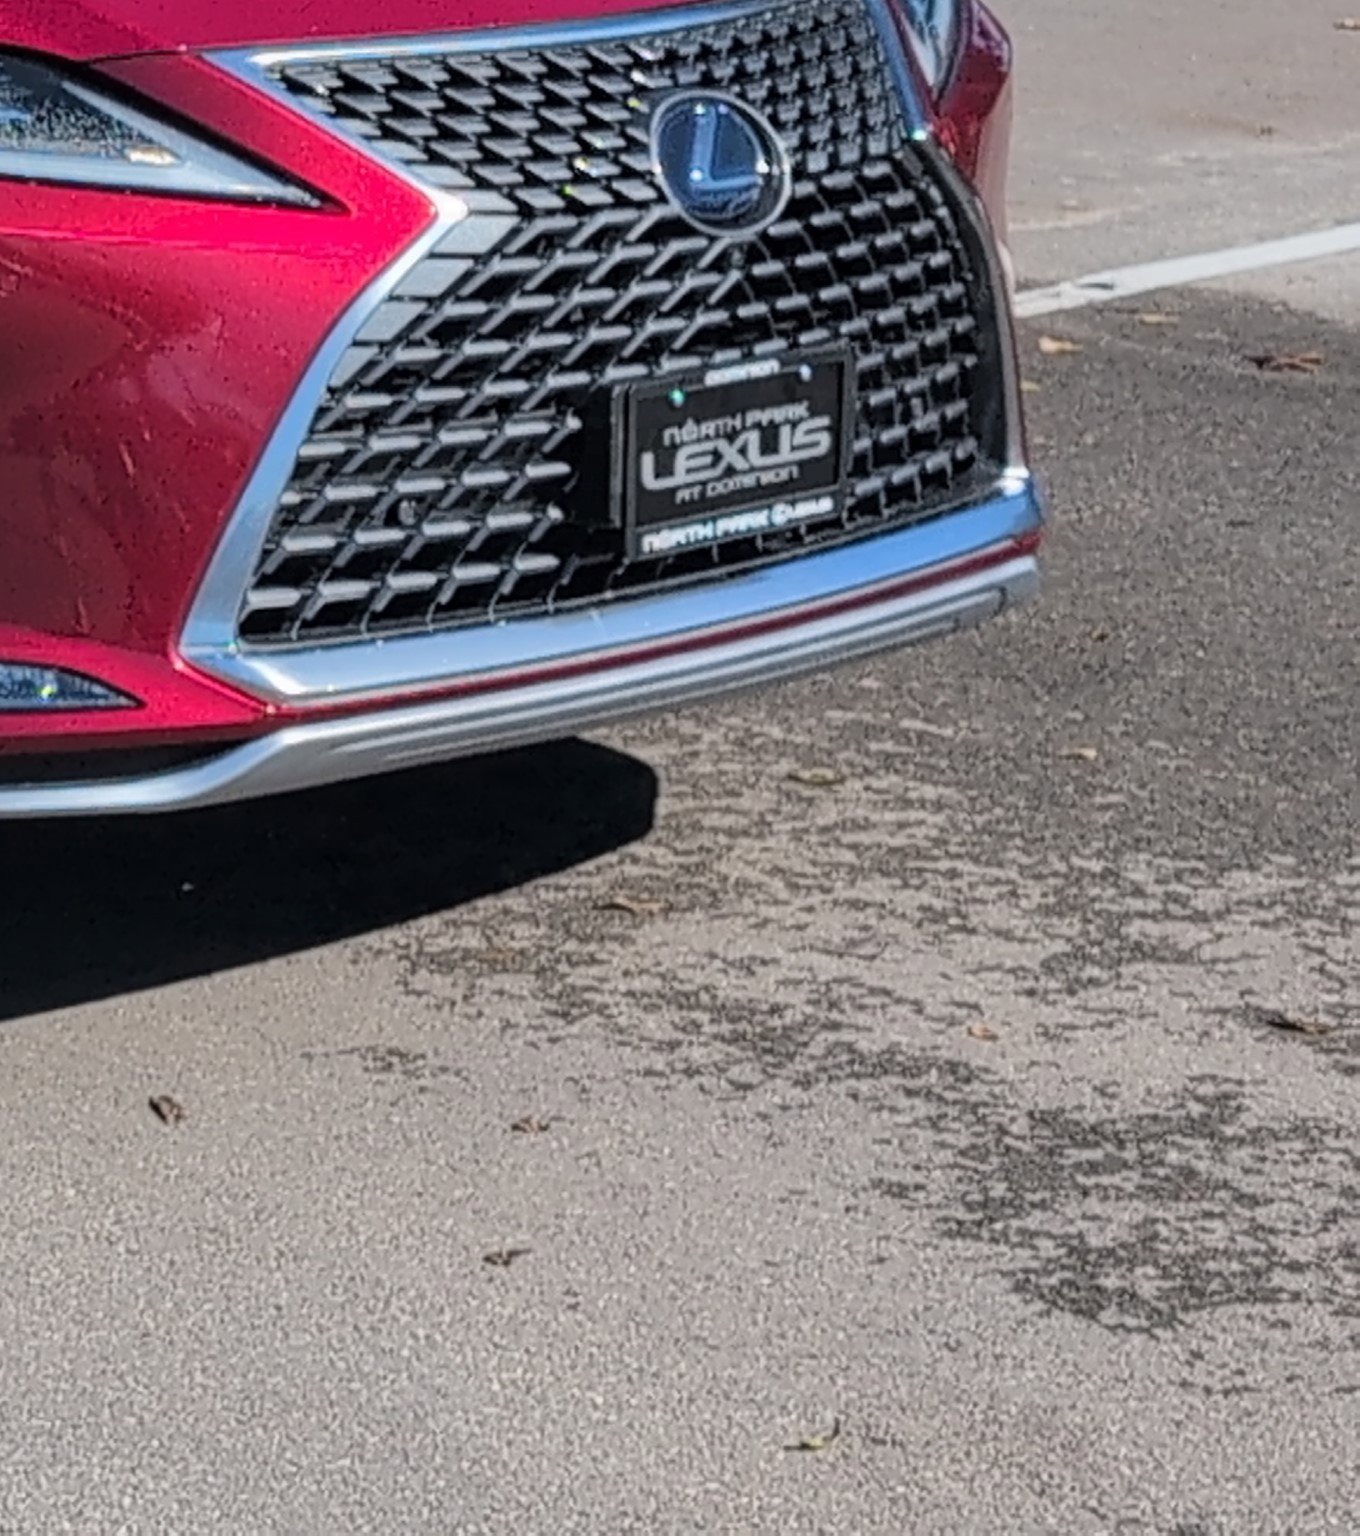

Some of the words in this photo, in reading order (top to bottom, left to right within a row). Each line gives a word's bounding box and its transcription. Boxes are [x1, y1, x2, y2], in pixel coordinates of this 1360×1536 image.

[663, 411, 743, 447] NORTH
[745, 400, 810, 427] PARK
[640, 415, 832, 490] LEXUS
[674, 485, 704, 504] AT
[705, 464, 800, 498] DOMINION
